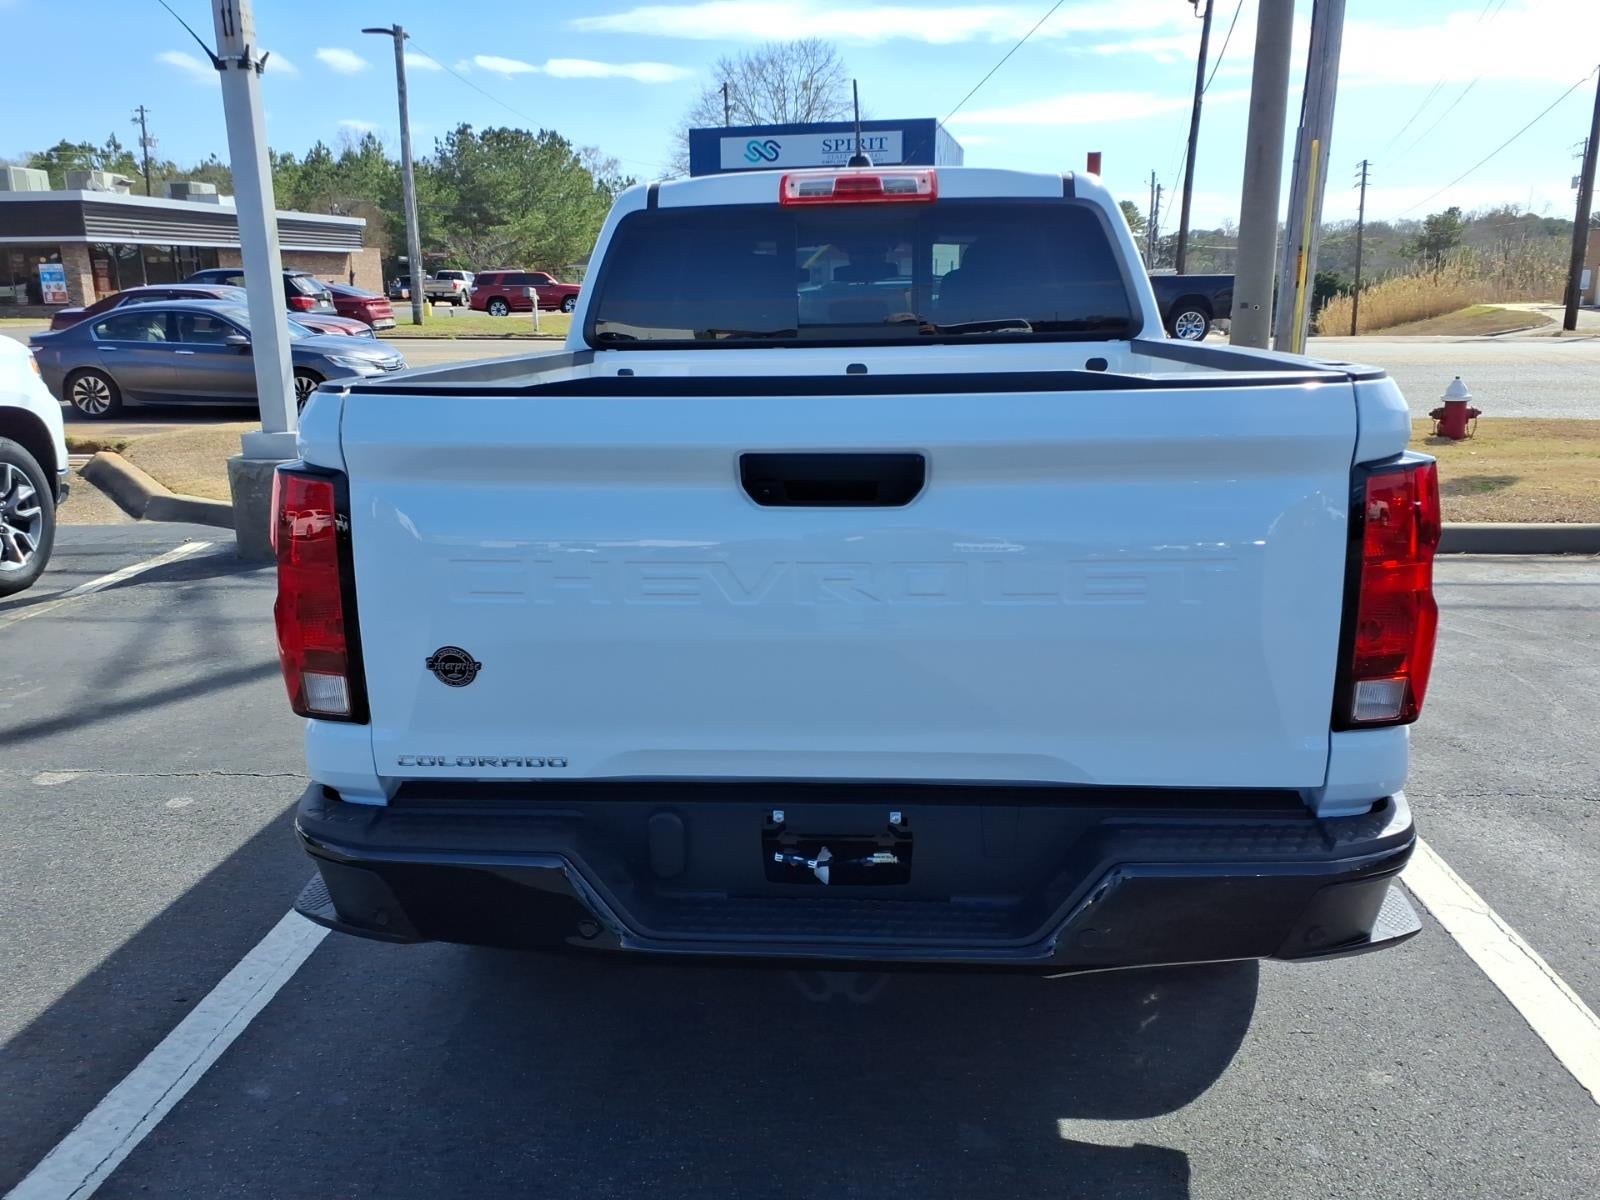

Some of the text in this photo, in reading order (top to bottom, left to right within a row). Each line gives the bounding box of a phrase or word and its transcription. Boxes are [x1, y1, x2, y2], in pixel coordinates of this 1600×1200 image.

[822, 137, 888, 152] SPIRIT
[447, 559, 1237, 607] CHEVROLET
[426, 657, 482, 673] Enterprise
[397, 754, 568, 768] COLORADO
